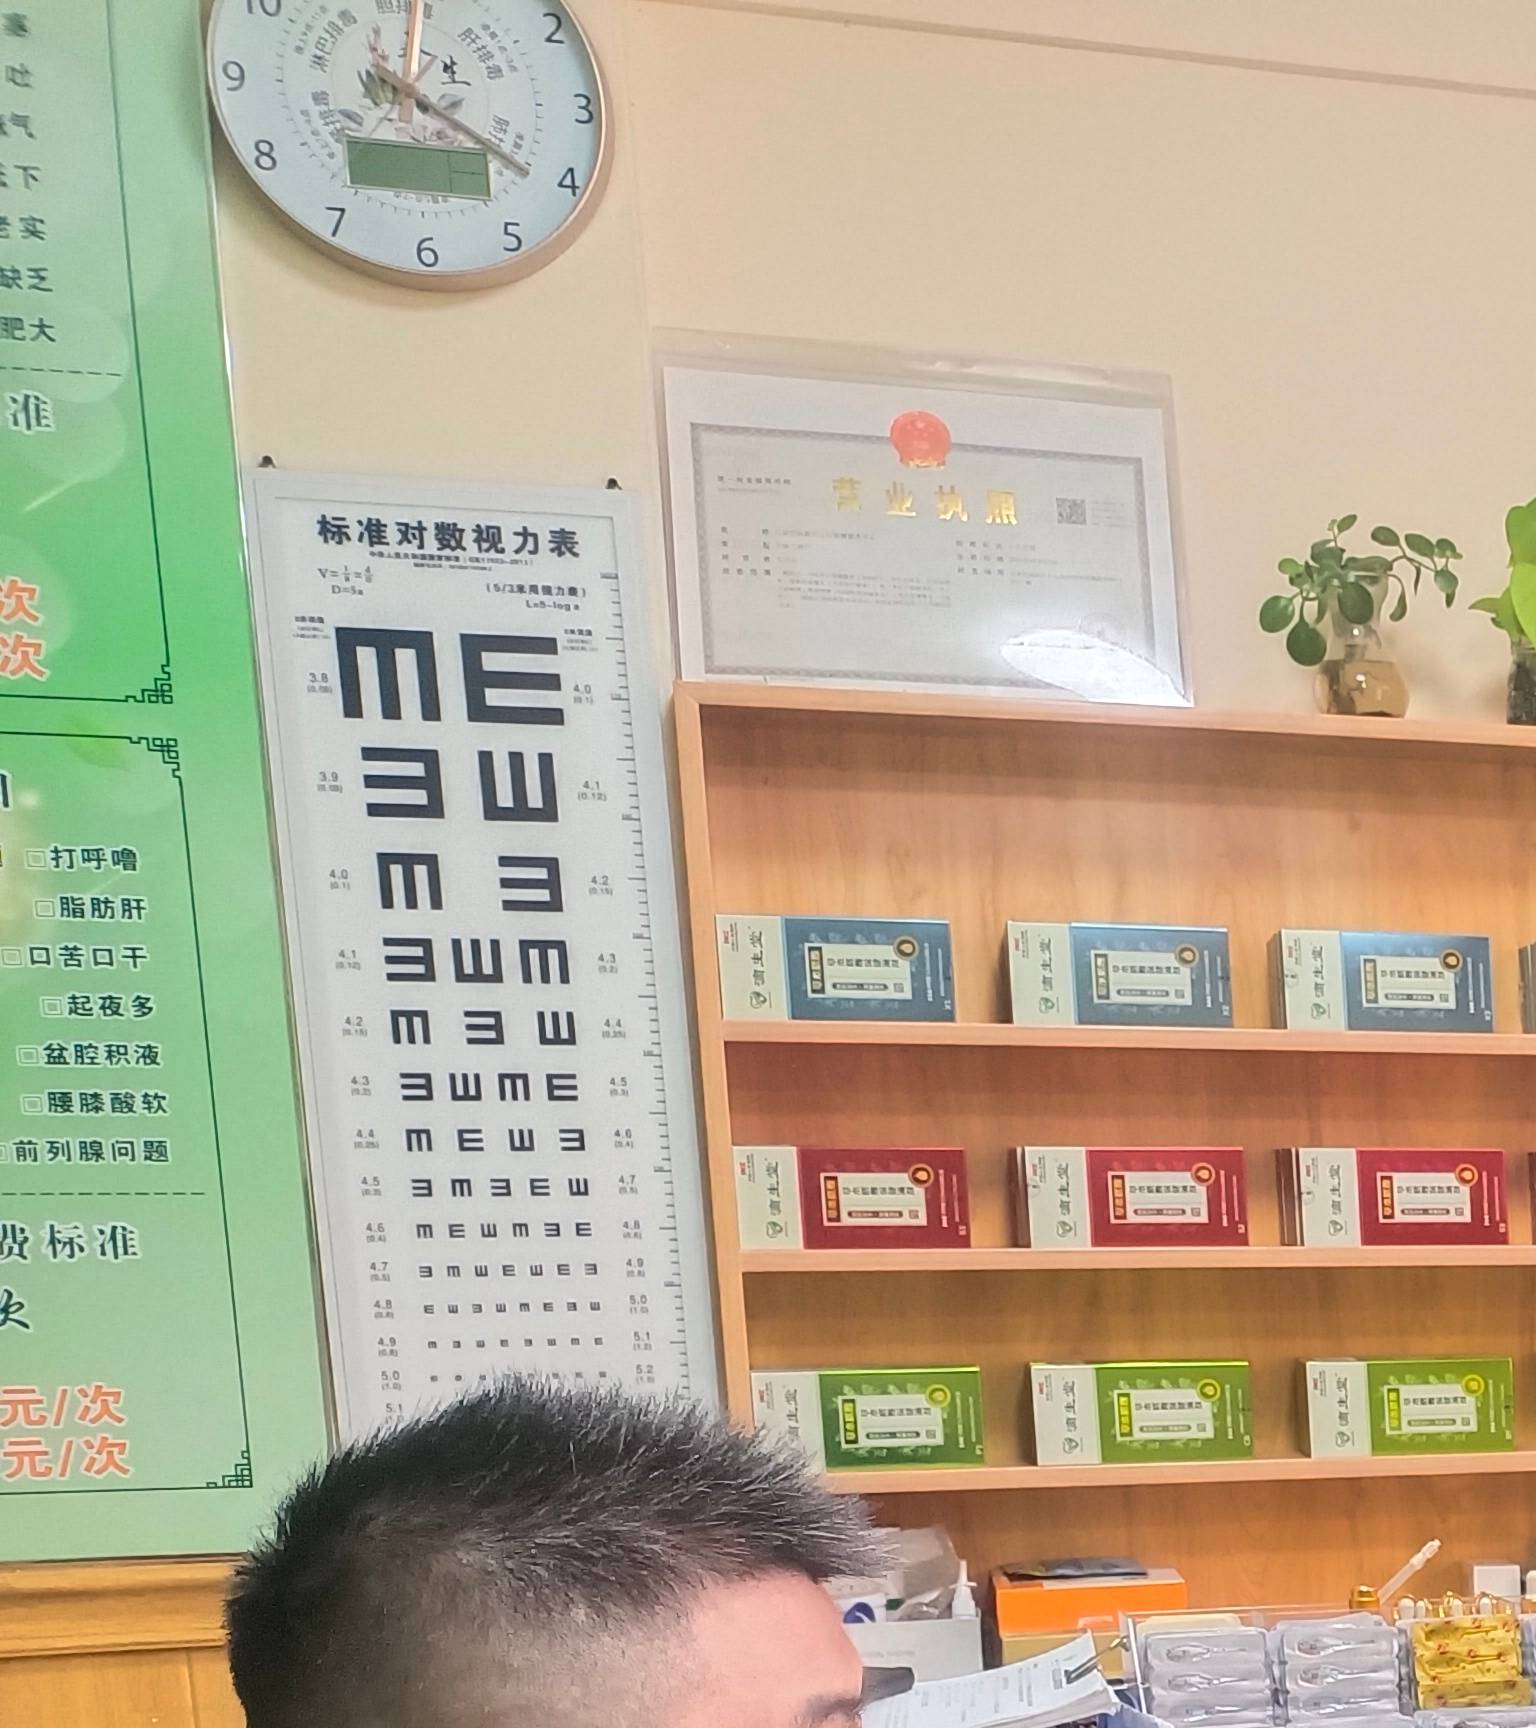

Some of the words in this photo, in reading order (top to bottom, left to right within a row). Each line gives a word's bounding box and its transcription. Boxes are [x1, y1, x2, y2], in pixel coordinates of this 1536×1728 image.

[543, 12, 565, 44] 2
[222, 60, 246, 91] 9
[573, 94, 594, 124] 3
[254, 139, 278, 171] 8
[557, 167, 580, 198] 4
[325, 206, 346, 238] 7
[503, 221, 523, 253] 5
[416, 237, 439, 268] 6
[831, 476, 1018, 527] 营业执照
[316, 513, 581, 559] 标准对数视力表
[50, 846, 139, 873] 打呼噜
[59, 895, 148, 921] 脂肪肝
[29, 945, 148, 970] 口苦口干
[67, 995, 155, 1019] 起夜多
[43, 1043, 162, 1067] 盆腔积液
[48, 1091, 169, 1115] 腰膝酸软
[12, 1139, 171, 1164] 前列腺问题
[0, 1384, 126, 1428] 元/次
[4, 1435, 131, 1479] 元/次
